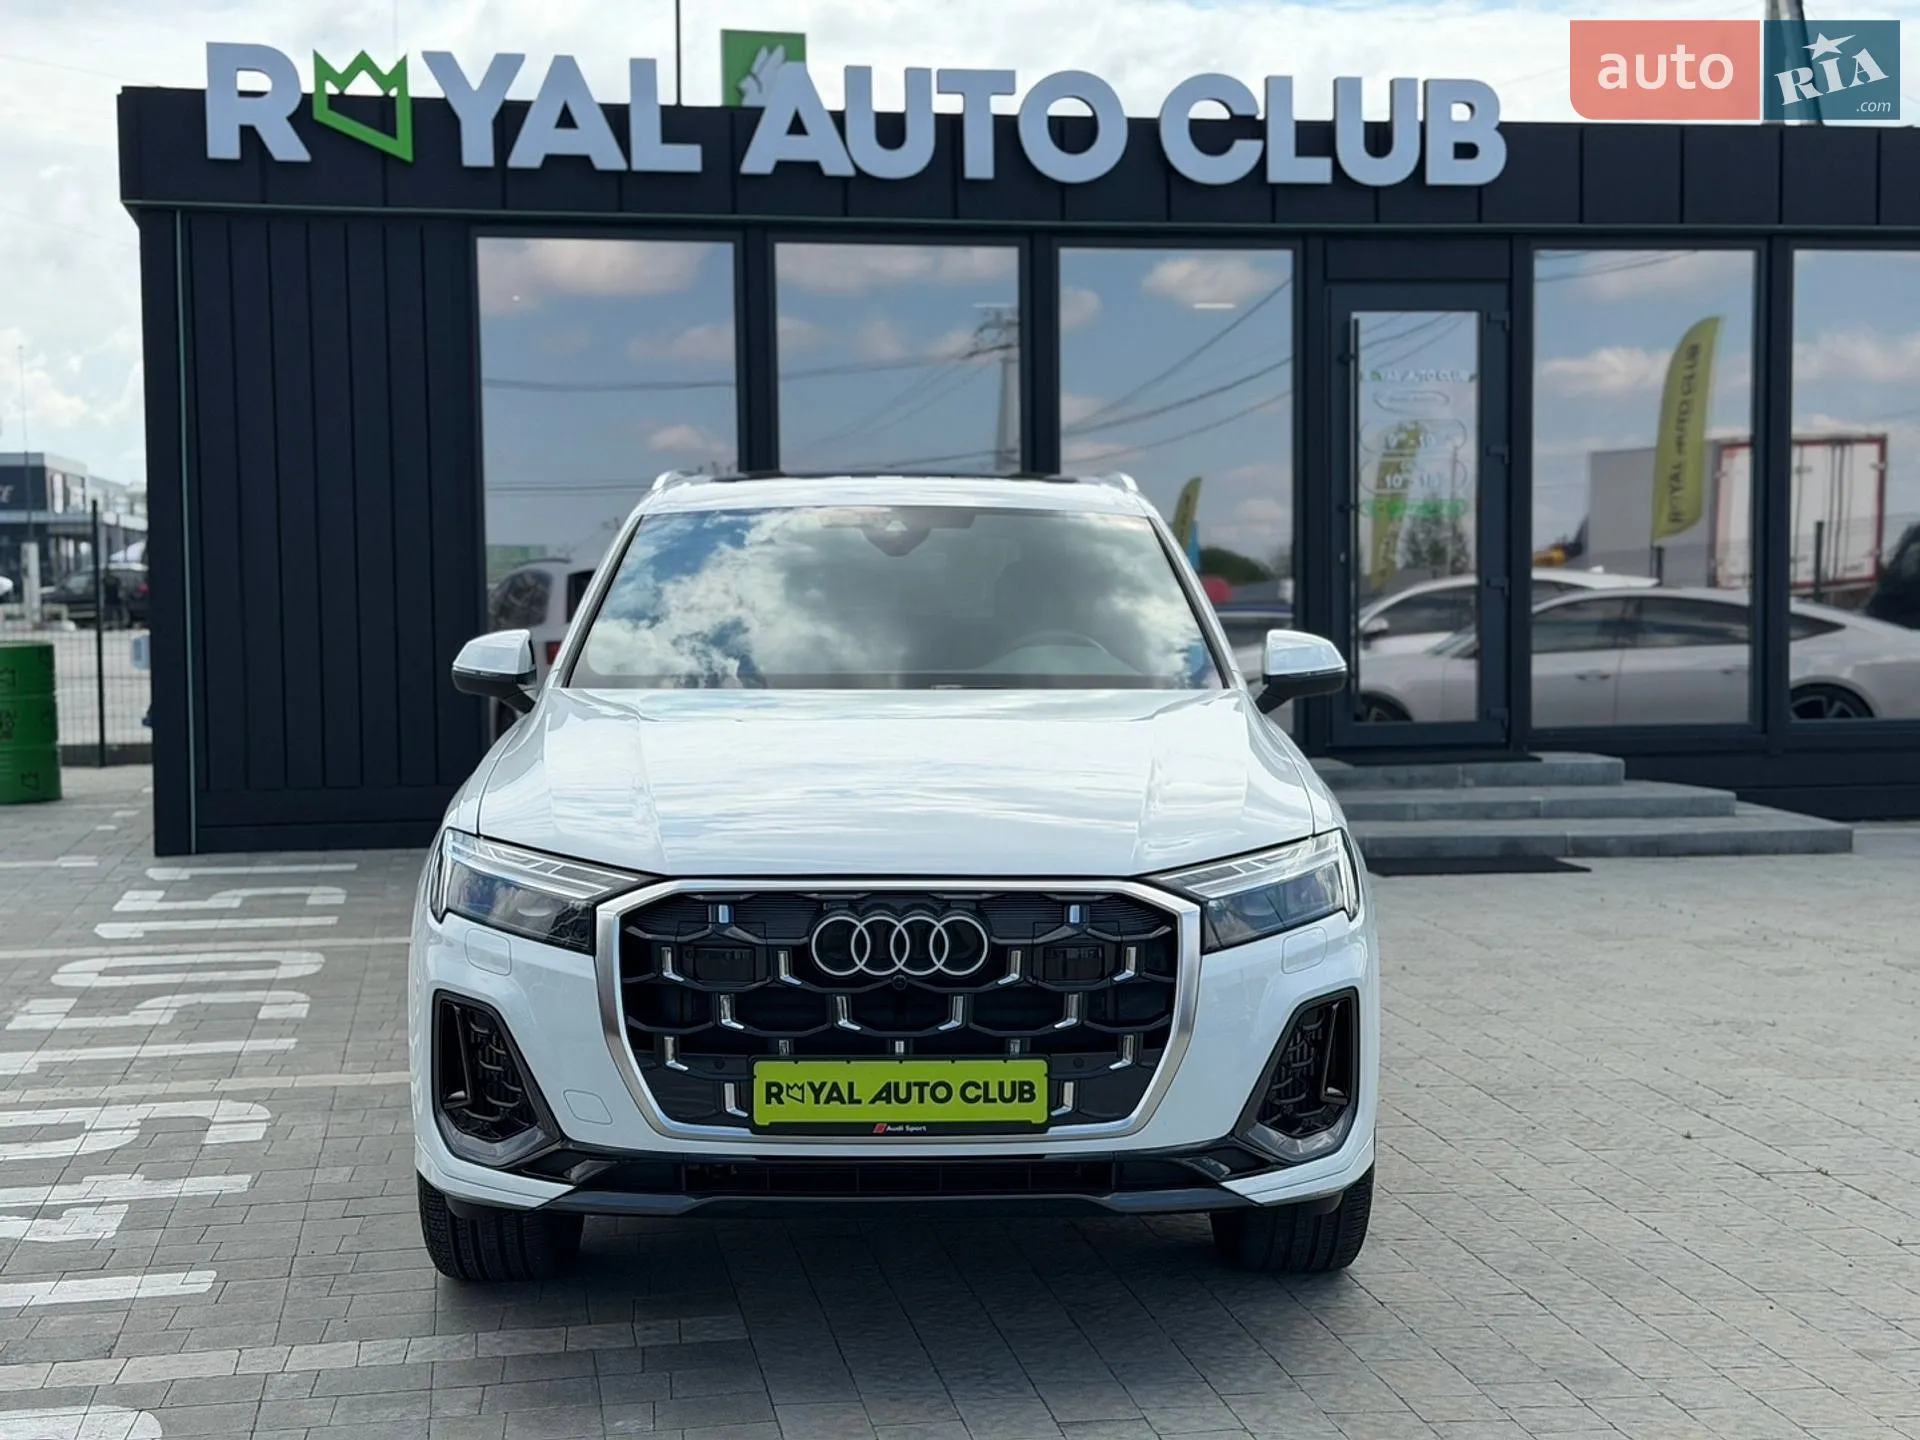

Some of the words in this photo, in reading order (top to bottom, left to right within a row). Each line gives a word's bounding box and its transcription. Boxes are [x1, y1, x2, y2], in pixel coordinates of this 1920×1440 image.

[740, 62, 1128, 183] AUTO
[1159, 72, 1507, 186] CLUB
[868, 1081, 953, 1105] AUTO
[959, 1080, 1036, 1105] CLUB
